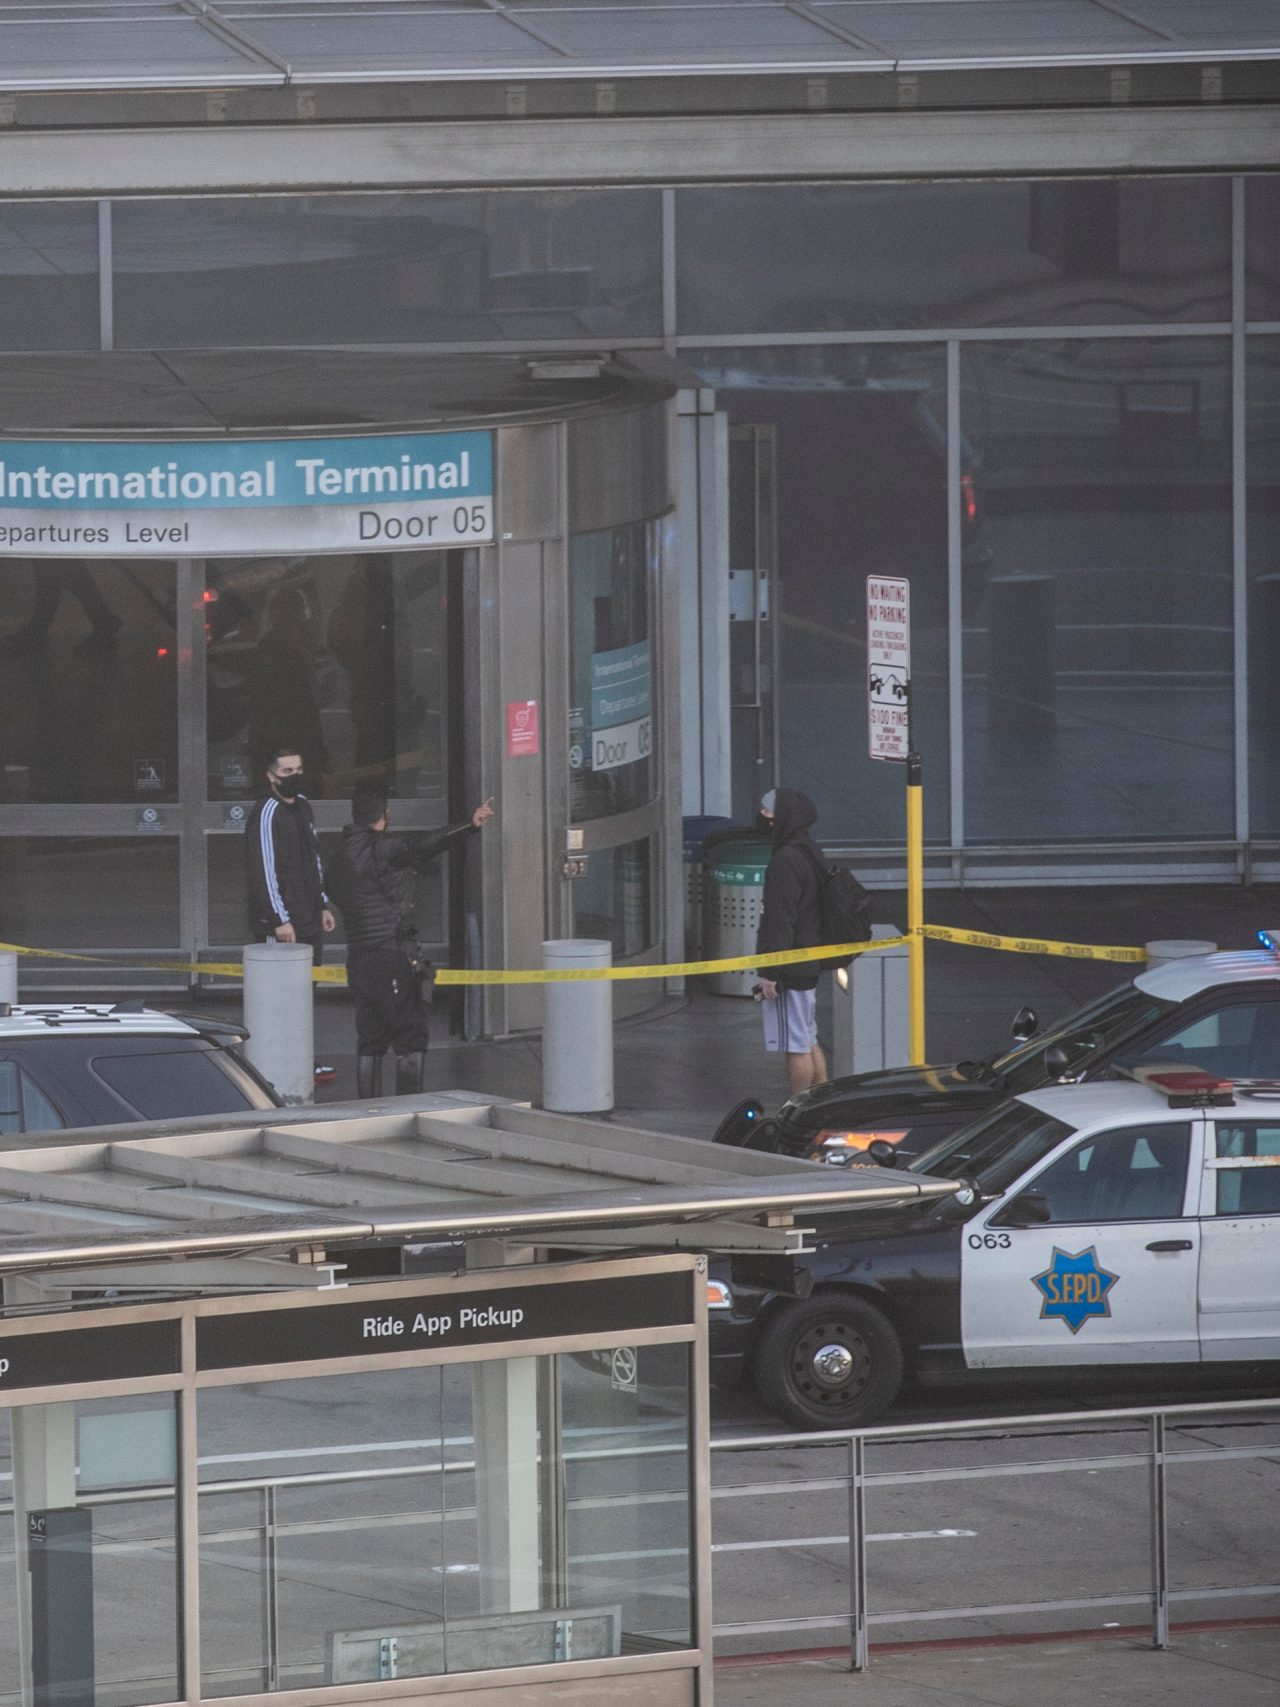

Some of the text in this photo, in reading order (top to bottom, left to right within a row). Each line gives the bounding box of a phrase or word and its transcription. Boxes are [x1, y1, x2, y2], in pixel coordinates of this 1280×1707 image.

[296, 451, 470, 496] Terminal
[125, 521, 190, 544] Level
[358, 505, 486, 541] Door 05
[596, 740, 628, 766] Door
[363, 1306, 524, 1338] Ride App Pickup
